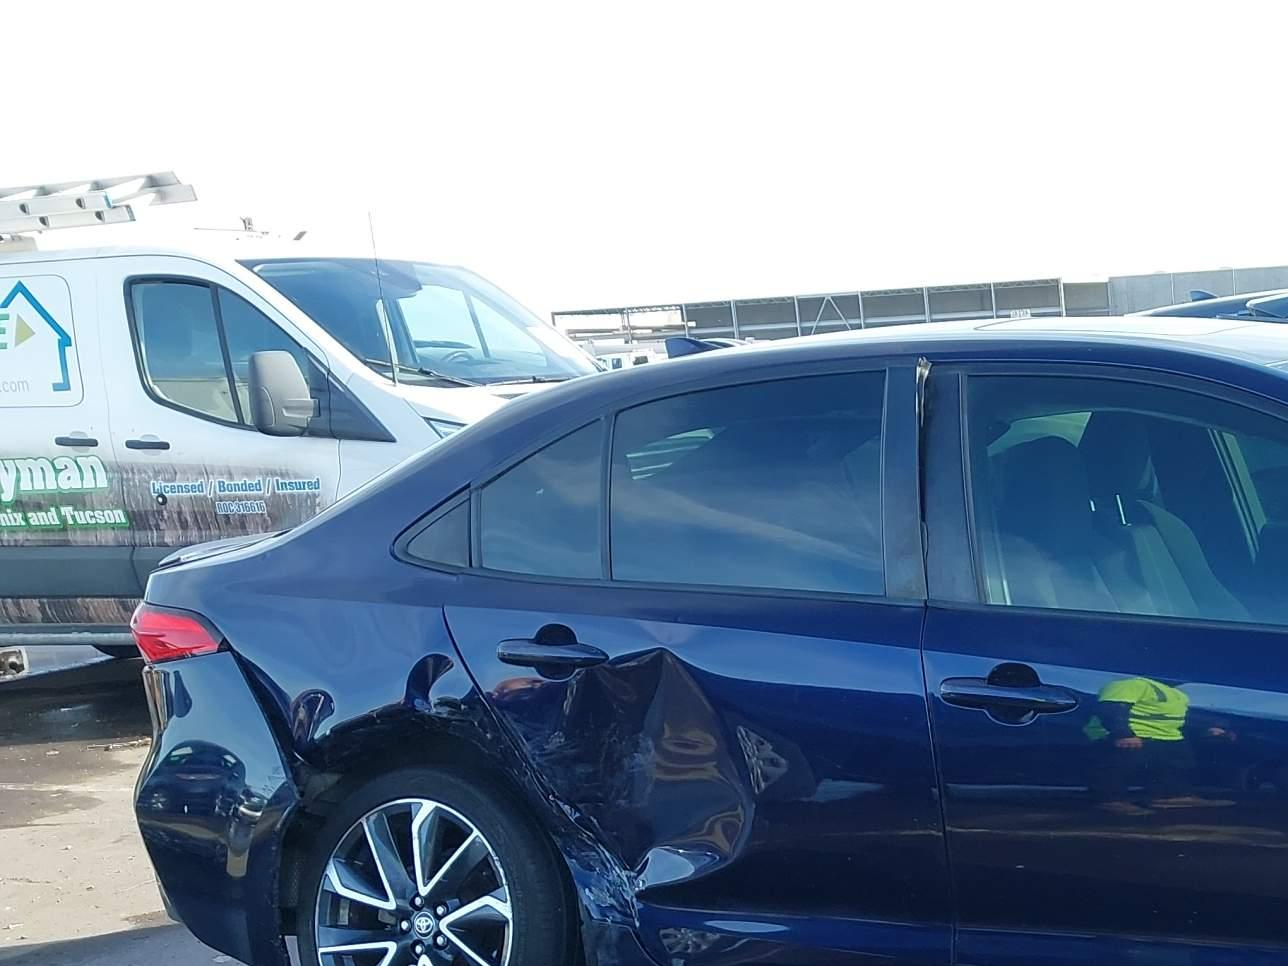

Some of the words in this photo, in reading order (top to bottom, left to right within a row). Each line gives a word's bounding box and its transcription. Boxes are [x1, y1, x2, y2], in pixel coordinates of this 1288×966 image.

[152, 480, 204, 494] Licensed
[218, 479, 262, 493] Bonded
[275, 478, 320, 492] Insured
[27, 507, 60, 525] and
[60, 506, 127, 525] Tucson
